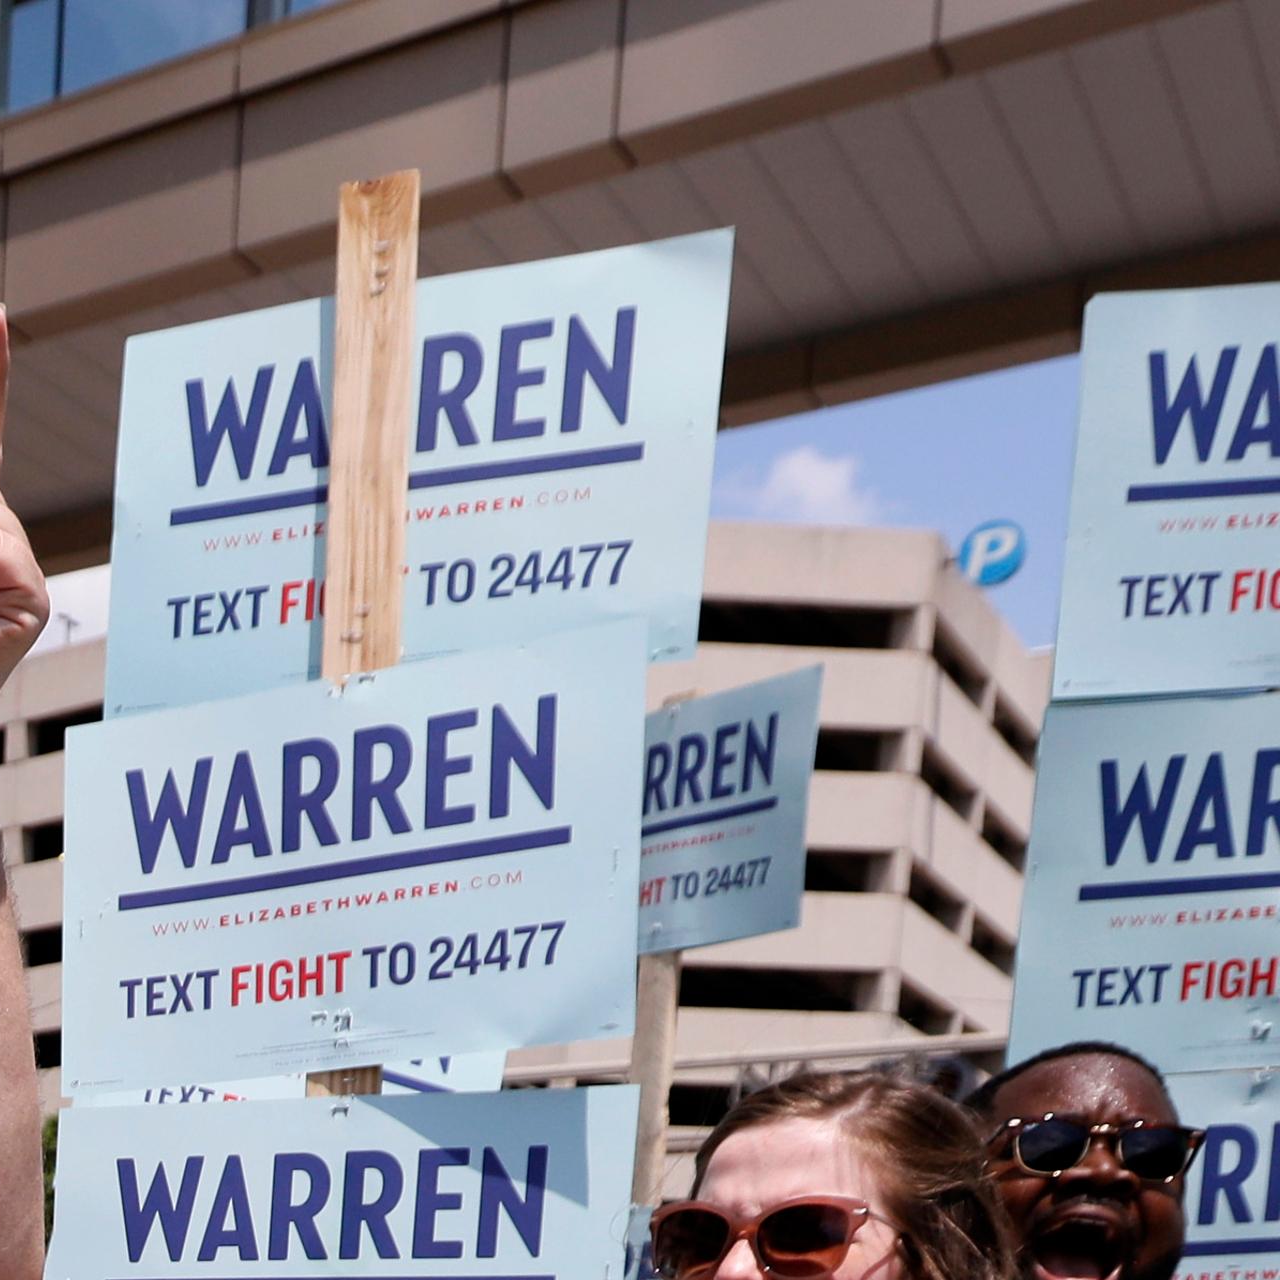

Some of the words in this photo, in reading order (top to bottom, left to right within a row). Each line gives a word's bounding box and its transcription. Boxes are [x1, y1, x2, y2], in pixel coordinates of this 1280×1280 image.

[185, 306, 637, 488] WAREN
[167, 585, 270, 640] TEXT
[420, 559, 475, 607] TO
[489, 539, 634, 600] 24477
[1119, 570, 1222, 619] TEXT
[125, 693, 559, 875] WARREN
[641, 711, 779, 816] RREN
[151, 869, 524, 937] WWW.ELIZABETHWARREN.COM
[671, 870, 699, 900] TO
[704, 856, 772, 897] 24477
[119, 969, 219, 1019] TEXT
[230, 951, 351, 1007] FIGHT
[362, 944, 416, 989] TO
[427, 921, 567, 980] 24477
[1072, 963, 1172, 1009] TEXT
[116, 1144, 549, 1263] WARREN
